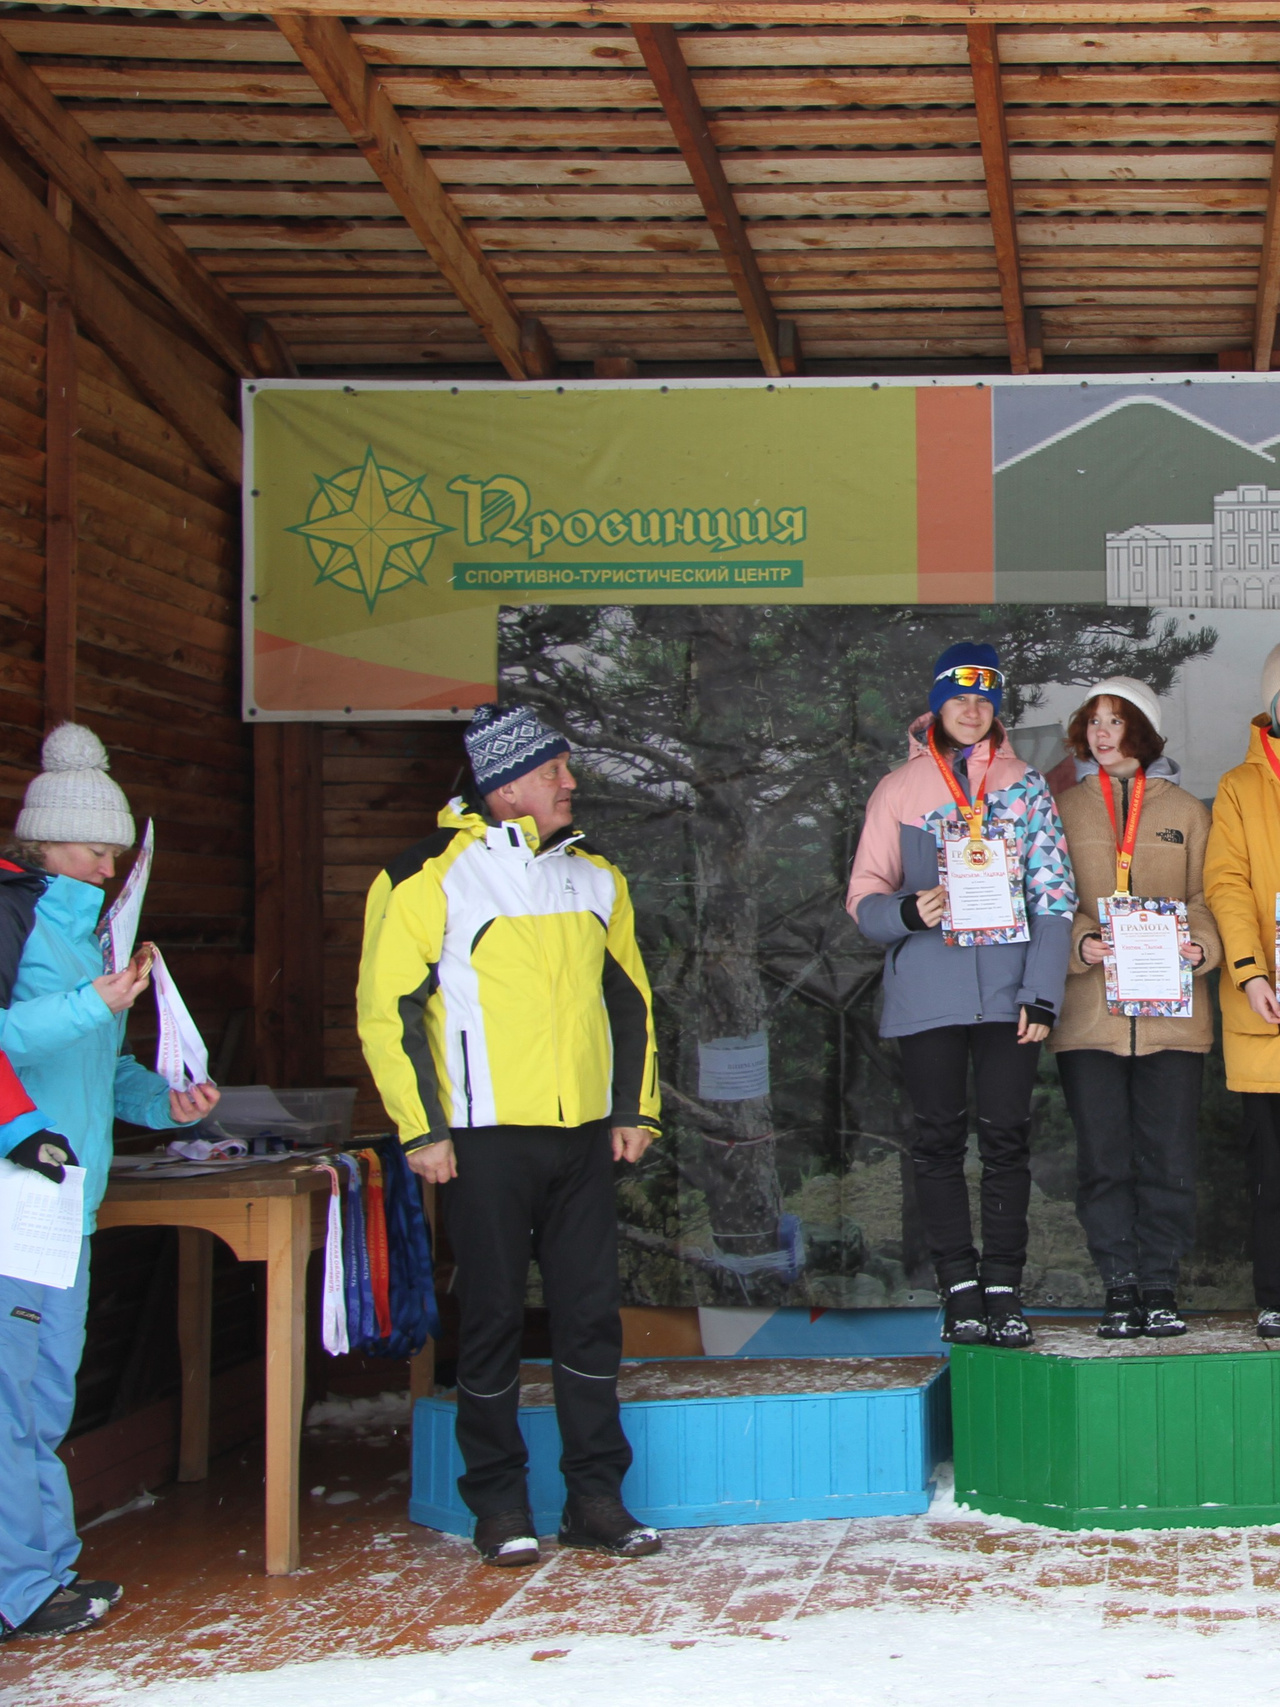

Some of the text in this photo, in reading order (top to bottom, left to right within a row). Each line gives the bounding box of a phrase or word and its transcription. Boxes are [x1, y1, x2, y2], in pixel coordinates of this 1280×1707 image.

[446, 474, 807, 560] Провинция
[465, 566, 792, 584] СПОРТИВНО-ТУРИСТИЧЕСКИЙ ЦЕНТР
[1120, 923, 1170, 931] ГРАМОТА
